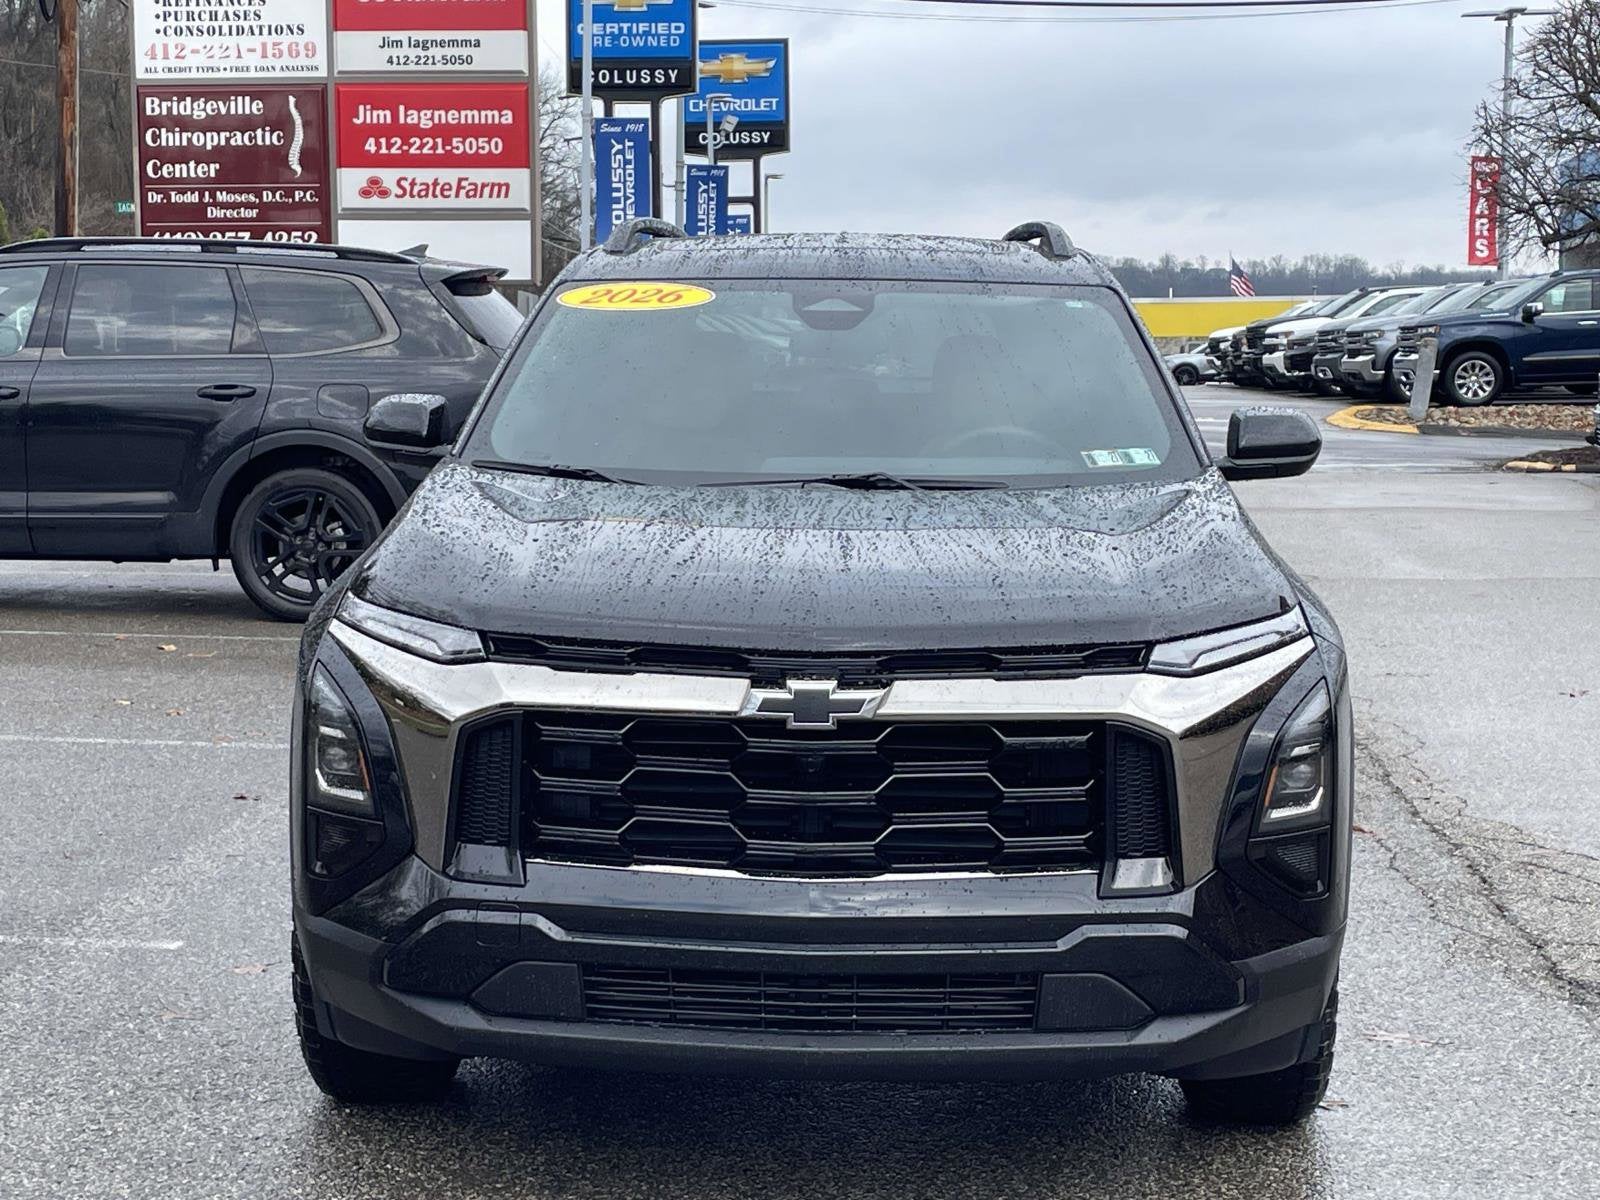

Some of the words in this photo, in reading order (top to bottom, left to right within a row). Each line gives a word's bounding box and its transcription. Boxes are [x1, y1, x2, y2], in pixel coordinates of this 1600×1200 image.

[162, 9, 262, 22] PURCHASES
[162, 24, 305, 37] CONSOLIDATIONS
[378, 36, 403, 49] Jim
[408, 36, 481, 51] Iagnemma
[593, 36, 680, 47] RE-OWNED
[143, 41, 317, 60] 412-221-1569
[386, 54, 474, 66] 412-221-5050
[143, 66, 159, 74] ALL
[162, 66, 193, 74] CREDIT
[195, 65, 221, 73] TYPES
[229, 65, 251, 73] FREE
[254, 65, 276, 73] LOAN
[278, 64, 320, 72] ANALYSIS
[591, 69, 679, 84] OLUSSY
[145, 96, 264, 119] Bridgeville
[352, 104, 392, 125] Jim
[398, 104, 513, 128] Iagnemma
[625, 123, 645, 132] 1918
[145, 127, 284, 150] Chiropractic
[364, 137, 504, 154] 412-221-5050
[146, 159, 220, 178] Center
[611, 138, 625, 231] OLUSSY
[625, 138, 635, 219] EVROLET
[147, 191, 167, 203] Dr.
[170, 191, 199, 203] Todd
[202, 191, 213, 203] J.
[216, 190, 260, 204] Moses,
[294, 190, 319, 203] P.C.
[207, 206, 259, 218] Director
[697, 180, 709, 236] LUSSY
[580, 288, 692, 304] 2026
